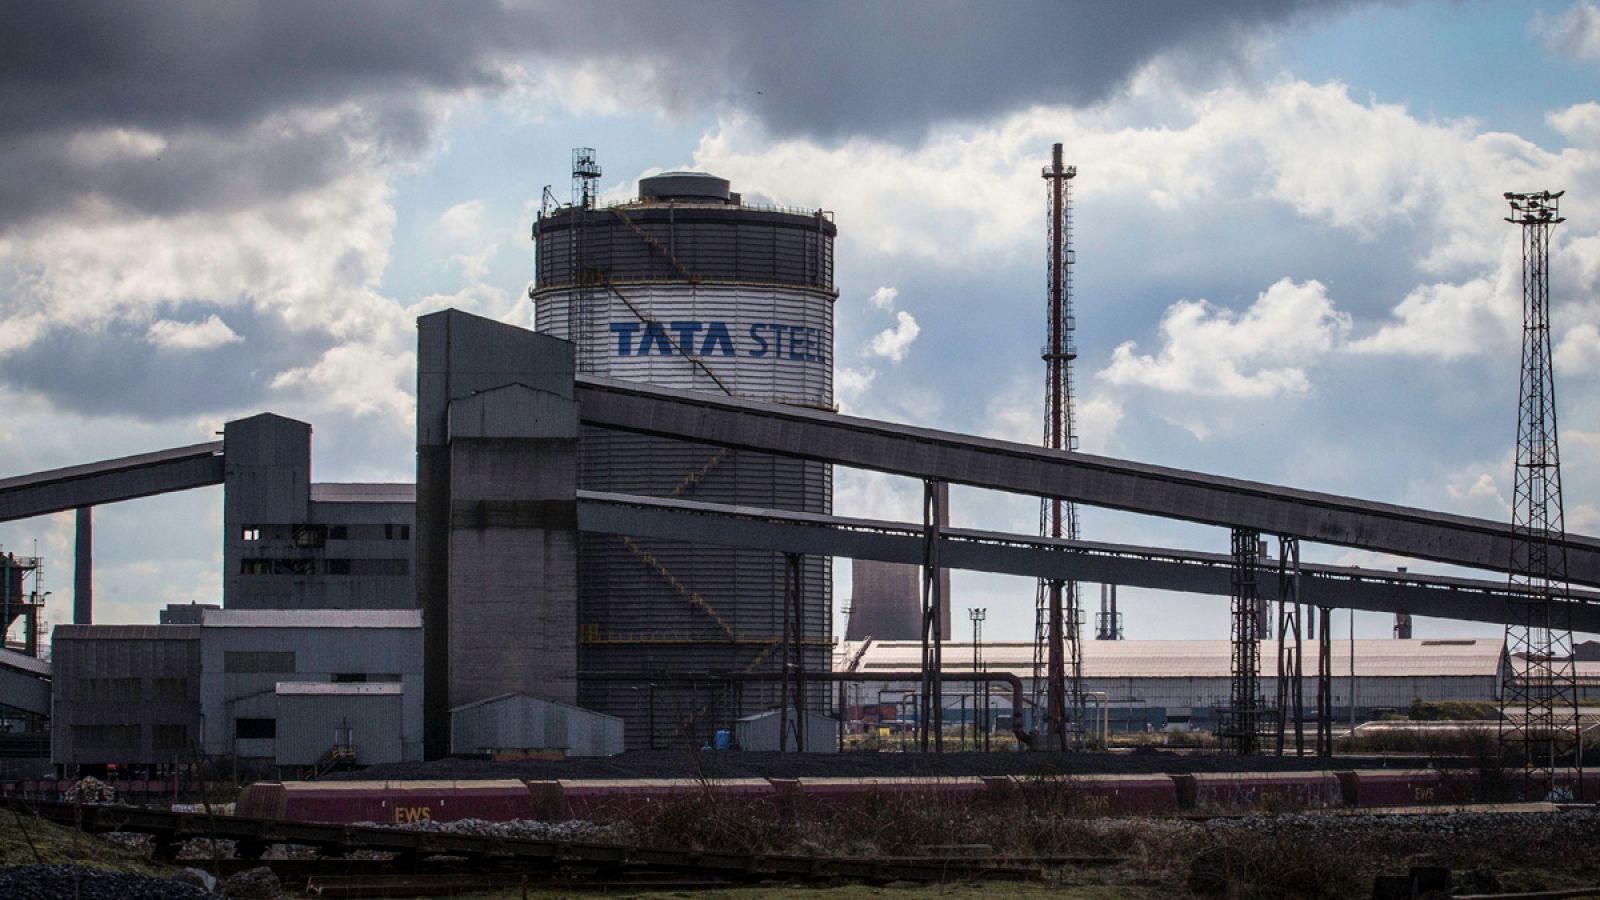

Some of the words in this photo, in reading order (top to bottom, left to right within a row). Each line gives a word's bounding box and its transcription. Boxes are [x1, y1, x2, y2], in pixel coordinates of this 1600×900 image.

[609, 320, 737, 357] TATA
[749, 323, 824, 364] STEEL
[396, 807, 431, 824] EWS
